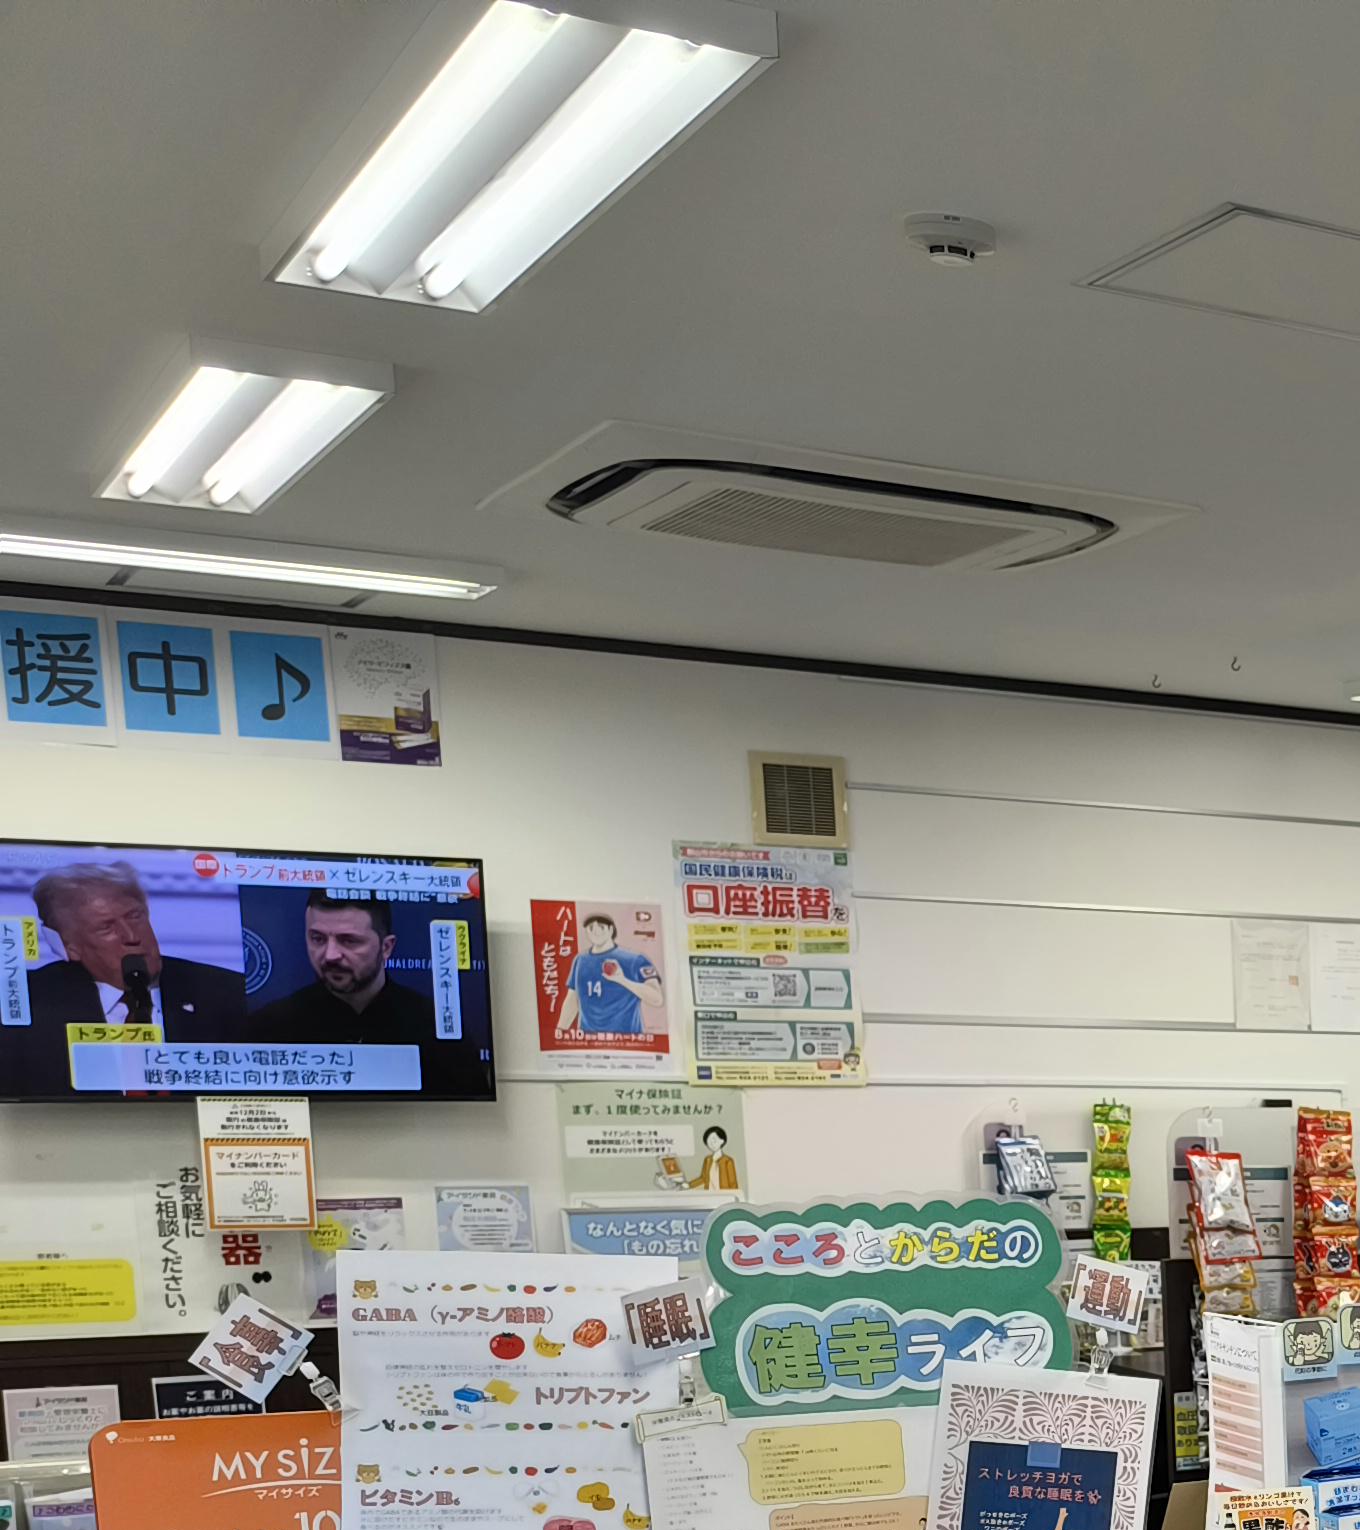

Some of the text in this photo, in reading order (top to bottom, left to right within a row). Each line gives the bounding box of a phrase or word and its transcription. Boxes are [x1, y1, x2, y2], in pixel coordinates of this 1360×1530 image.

[5, 627, 102, 709] 援
[128, 641, 208, 716] 中
[685, 882, 849, 923] 口座振替を
[586, 980, 602, 998] 14
[74, 1027, 156, 1043] トランプ氏
[144, 1049, 355, 1067] 「とても良い電話だった」
[144, 1069, 356, 1087] 戦争終結に向け意欲示す
[613, 1087, 683, 1101] マイナ保険証
[221, 1232, 263, 1266] 器
[730, 1227, 1037, 1268] こころとからだの
[747, 1316, 1047, 1394] 健幸ライフ
[534, 1386, 651, 1407] トリプトファン
[977, 1467, 1084, 1487] ストレッチヨガで
[253, 1485, 322, 1501] マイサイズ
